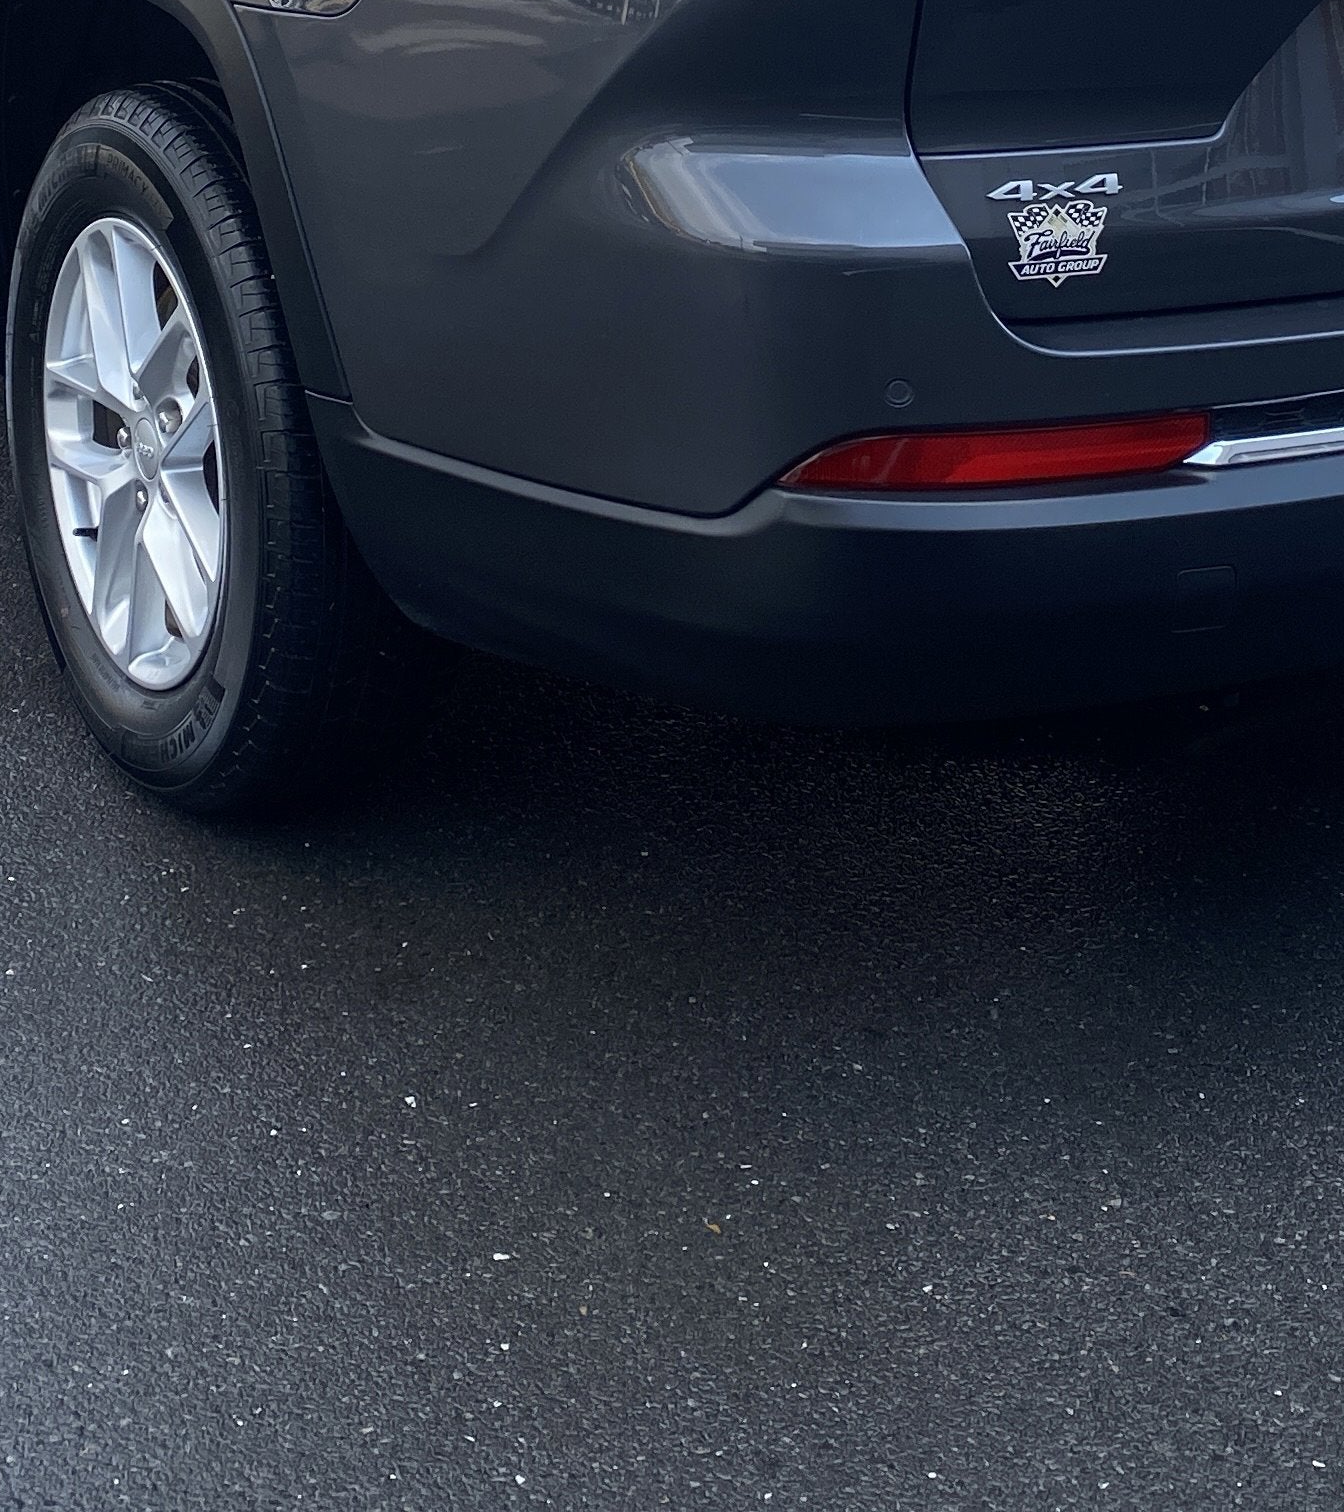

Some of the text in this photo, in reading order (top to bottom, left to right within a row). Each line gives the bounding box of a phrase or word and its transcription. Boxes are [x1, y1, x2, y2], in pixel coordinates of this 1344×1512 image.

[107, 152, 149, 193] PRIMACY
[986, 173, 1123, 201] 4x4
[1024, 229, 1095, 260] Fairfield
[1020, 259, 1099, 275] AUTO GROUP
